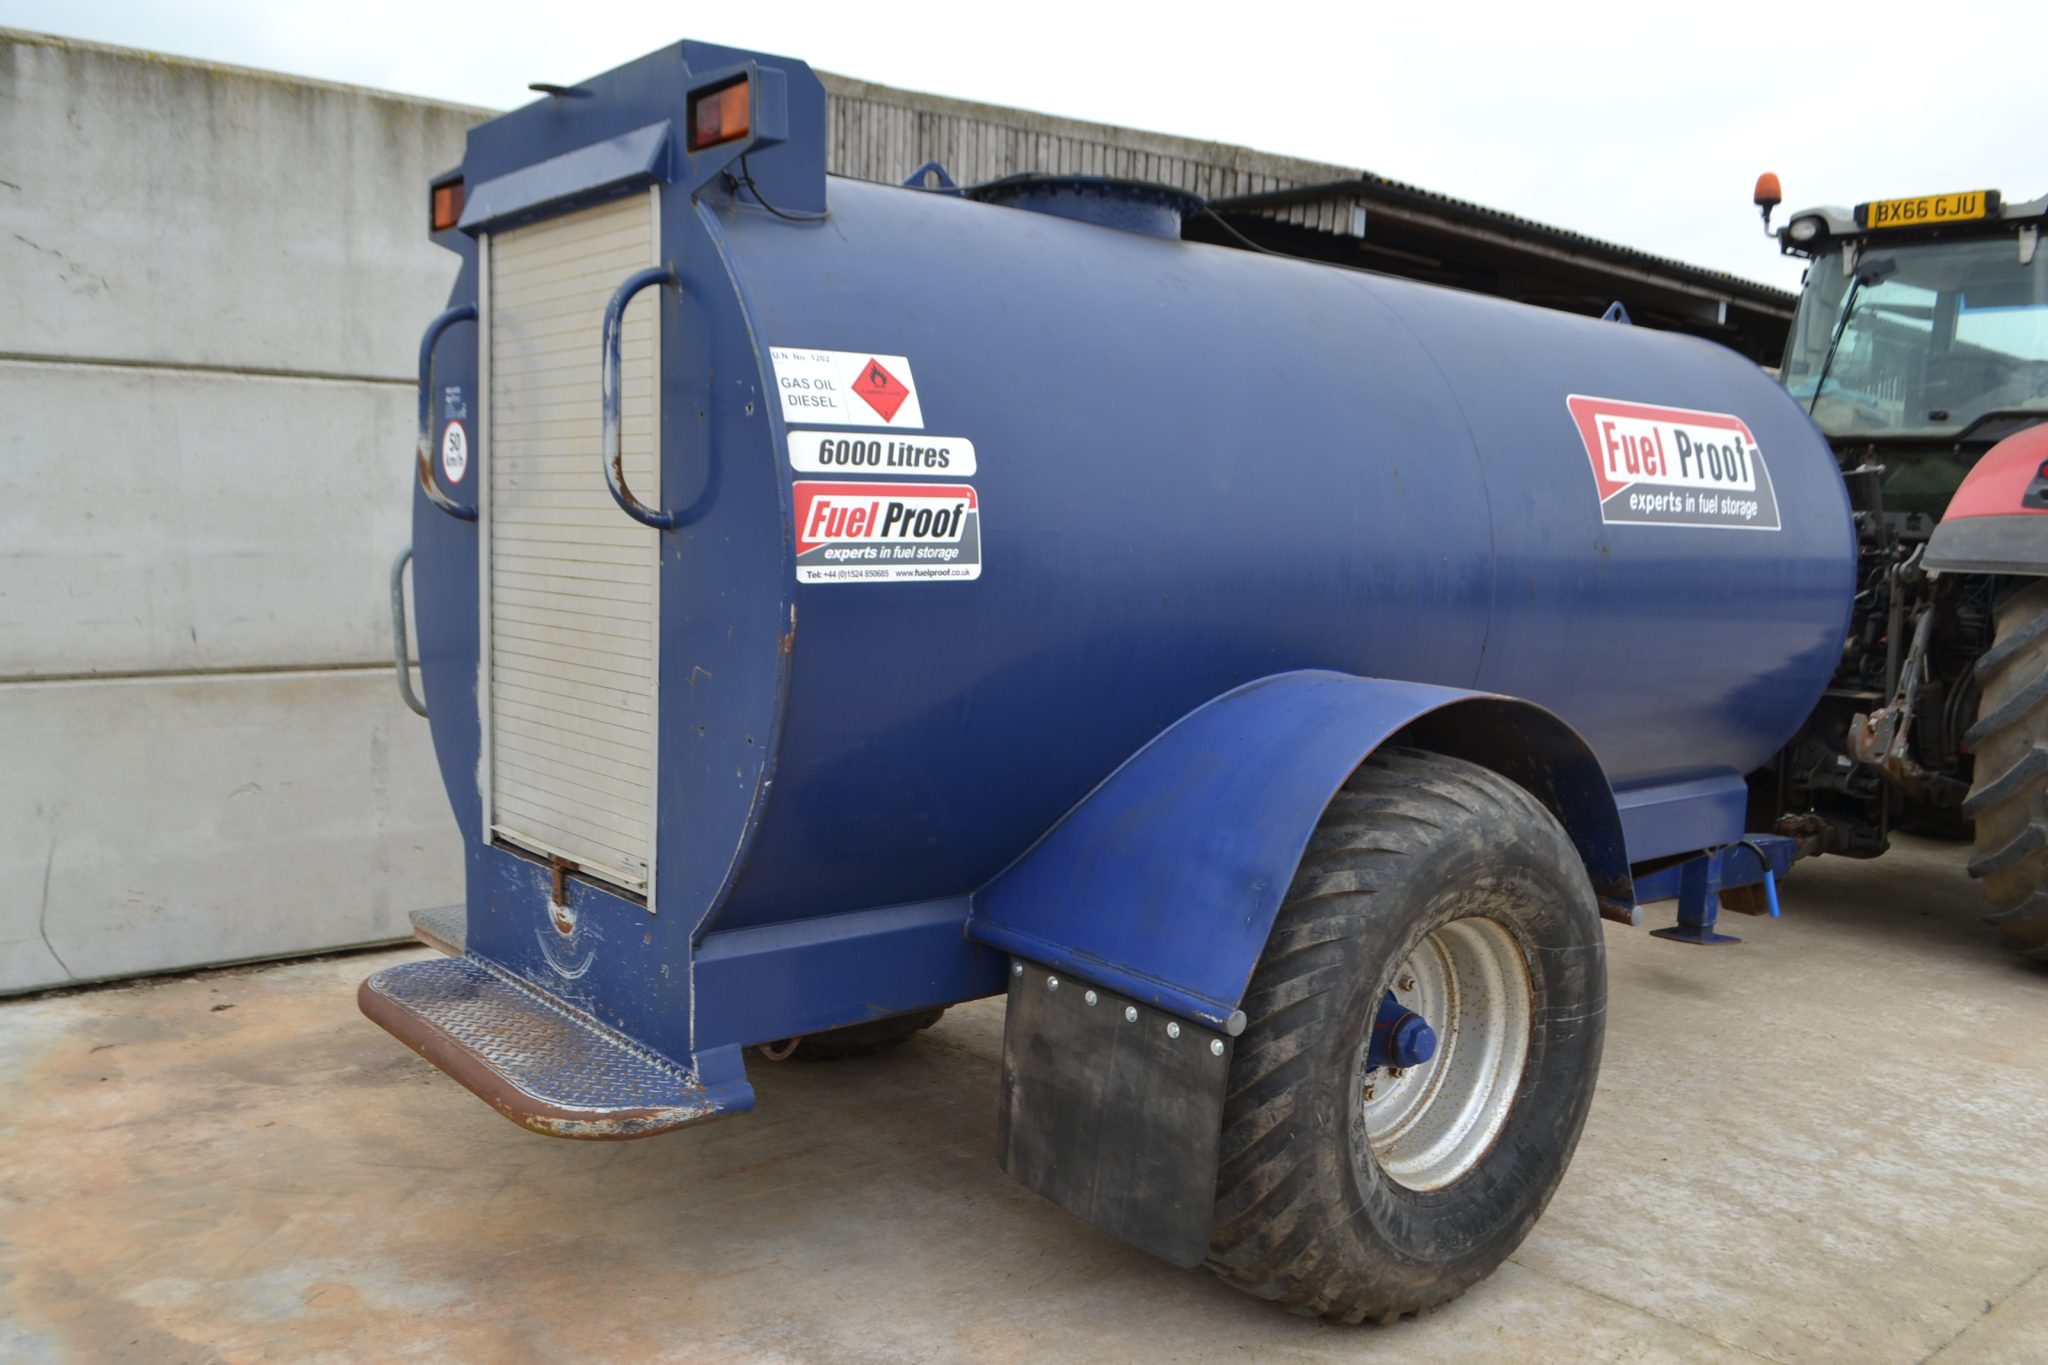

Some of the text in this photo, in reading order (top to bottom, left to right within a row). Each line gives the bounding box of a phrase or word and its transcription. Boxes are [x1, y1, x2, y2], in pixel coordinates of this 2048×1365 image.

[1876, 200, 1928, 223] BX66
[781, 376, 837, 391] GAS OIL
[788, 394, 837, 408] DIESEL
[818, 439, 950, 468] 6000 Litres
[1602, 421, 1748, 483] Fuel Proof
[1630, 491, 1758, 520] experts in fuel storage
[808, 501, 964, 538] Fuel Proof
[824, 546, 959, 562] experts in fuel storage
[895, 568, 970, 578] www.fuelproof.co.uk
